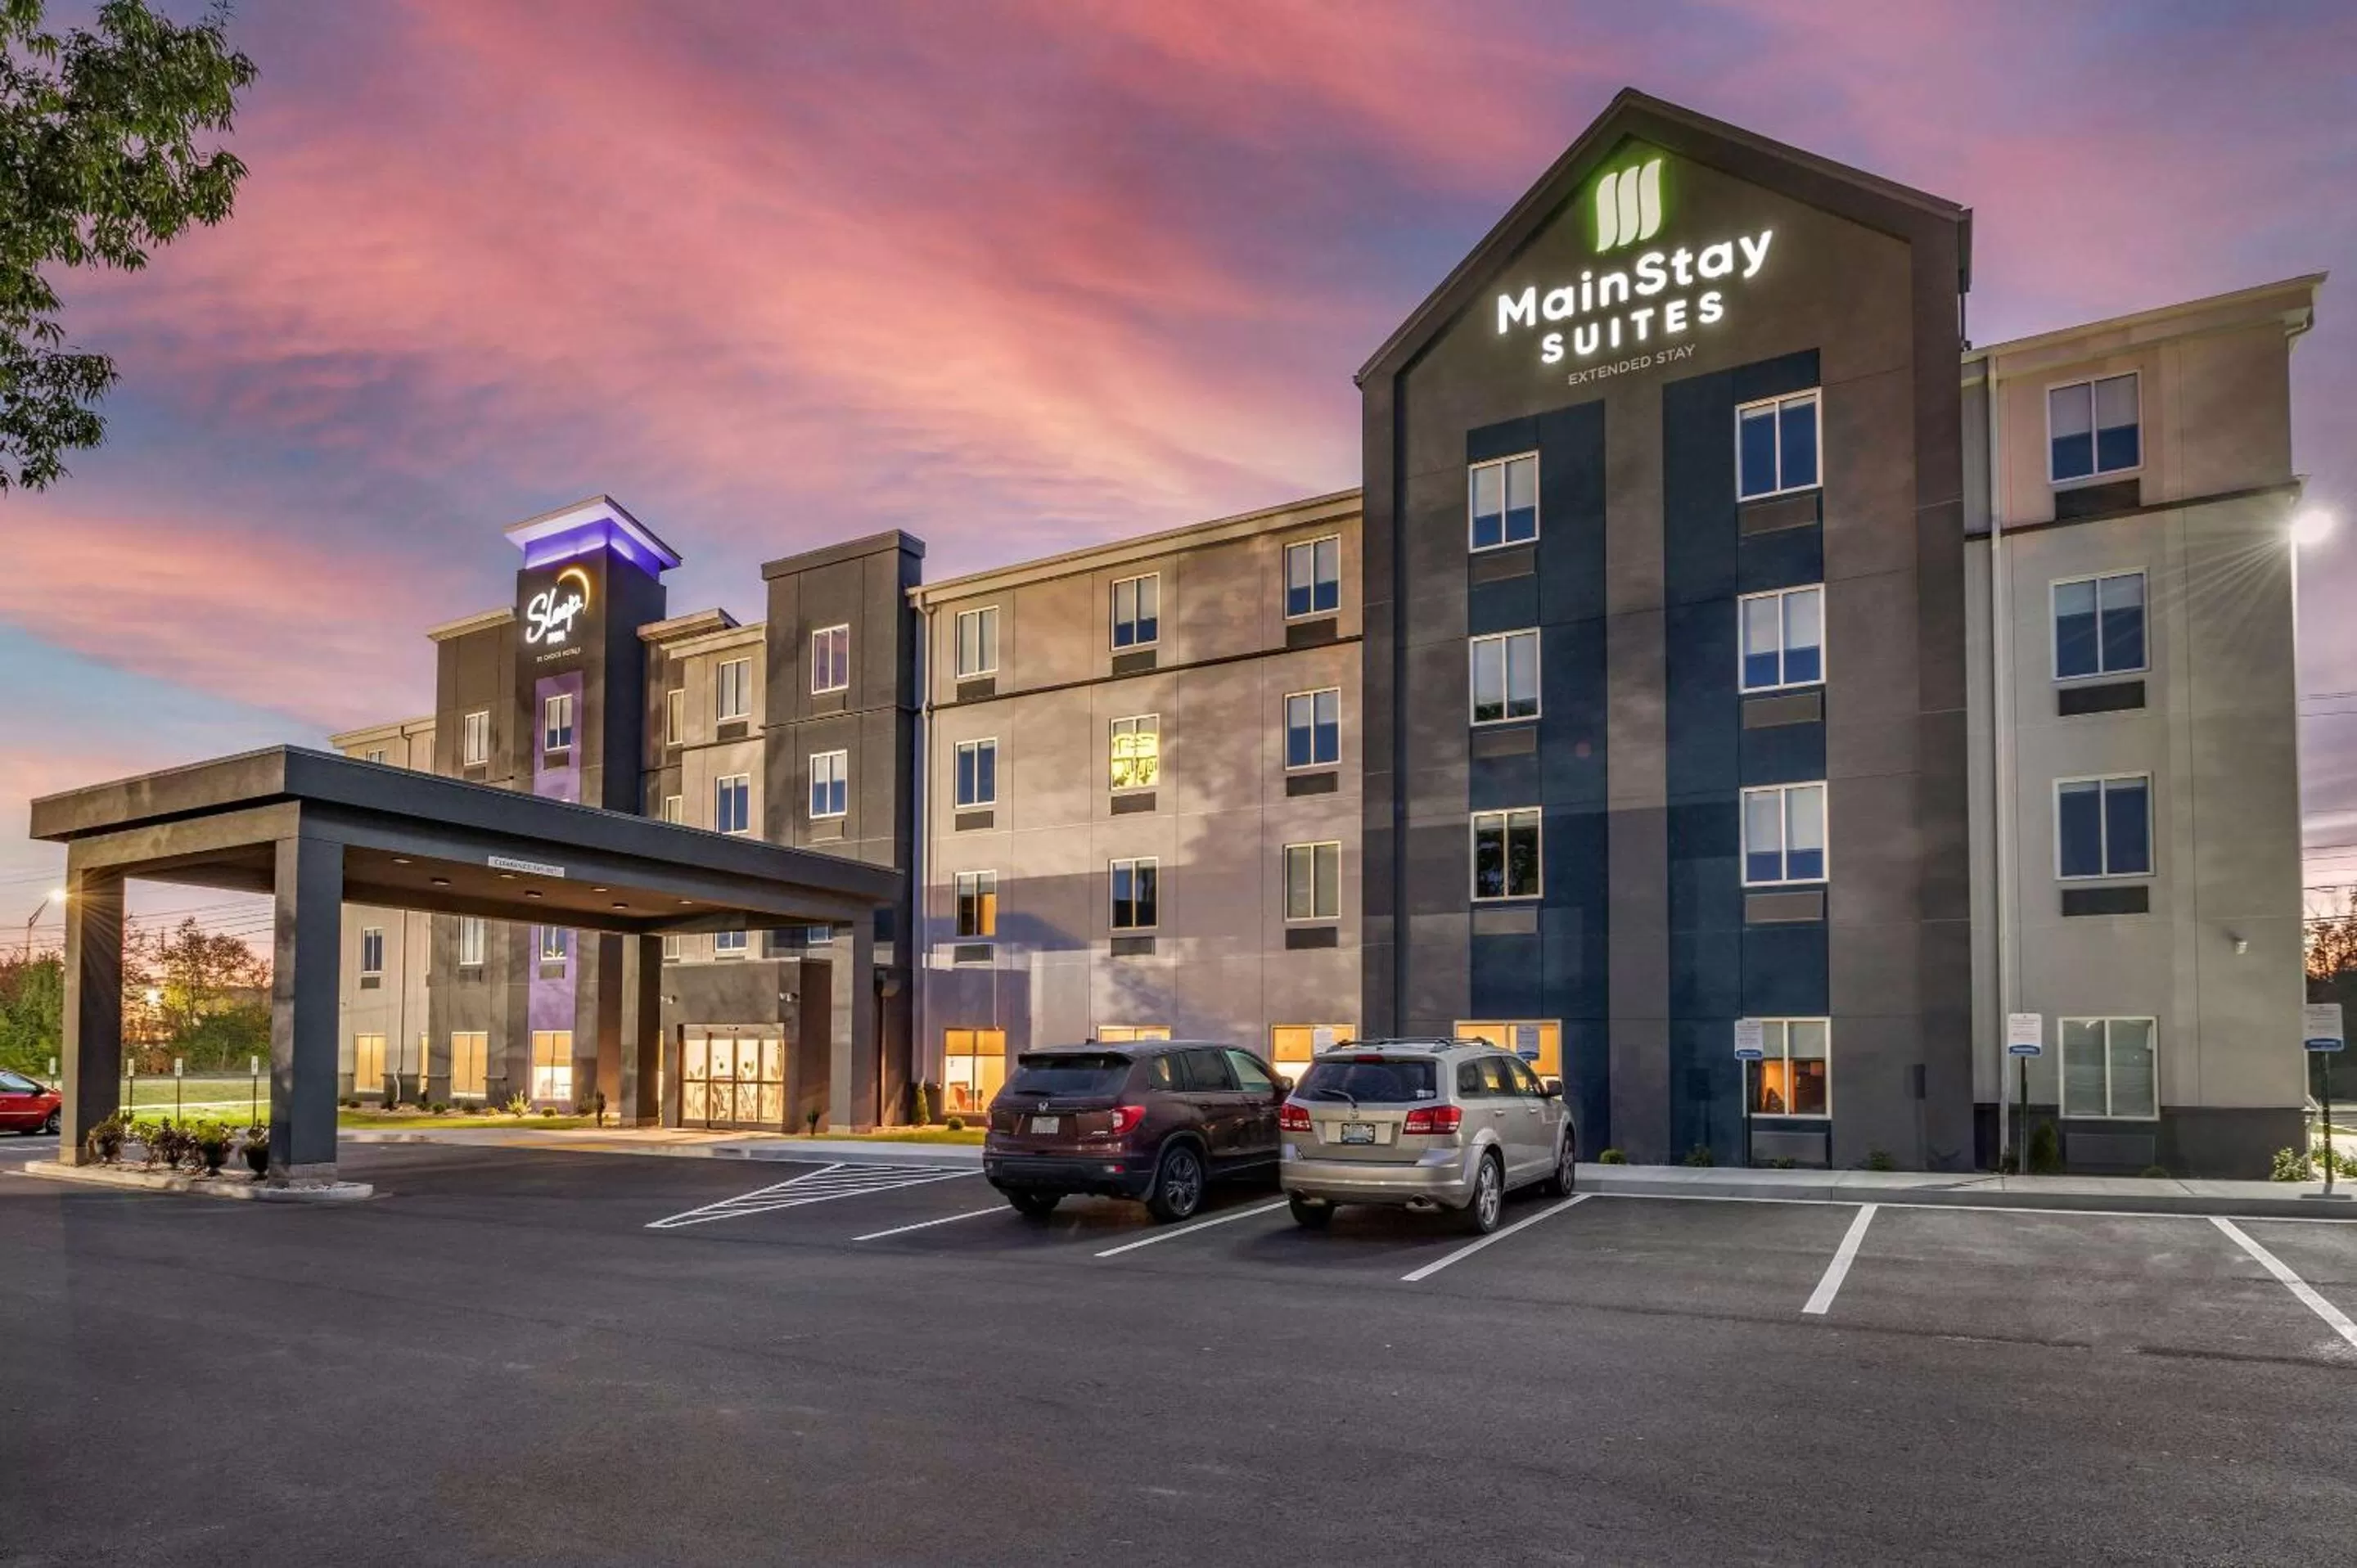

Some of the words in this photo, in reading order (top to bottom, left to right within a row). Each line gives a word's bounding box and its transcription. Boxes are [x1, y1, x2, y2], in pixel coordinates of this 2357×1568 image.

[1497, 229, 1773, 335] MainStay
[1541, 291, 1724, 364] SUITES
[1567, 355, 1652, 385] EXTENDED
[1656, 344, 1696, 364] STAY
